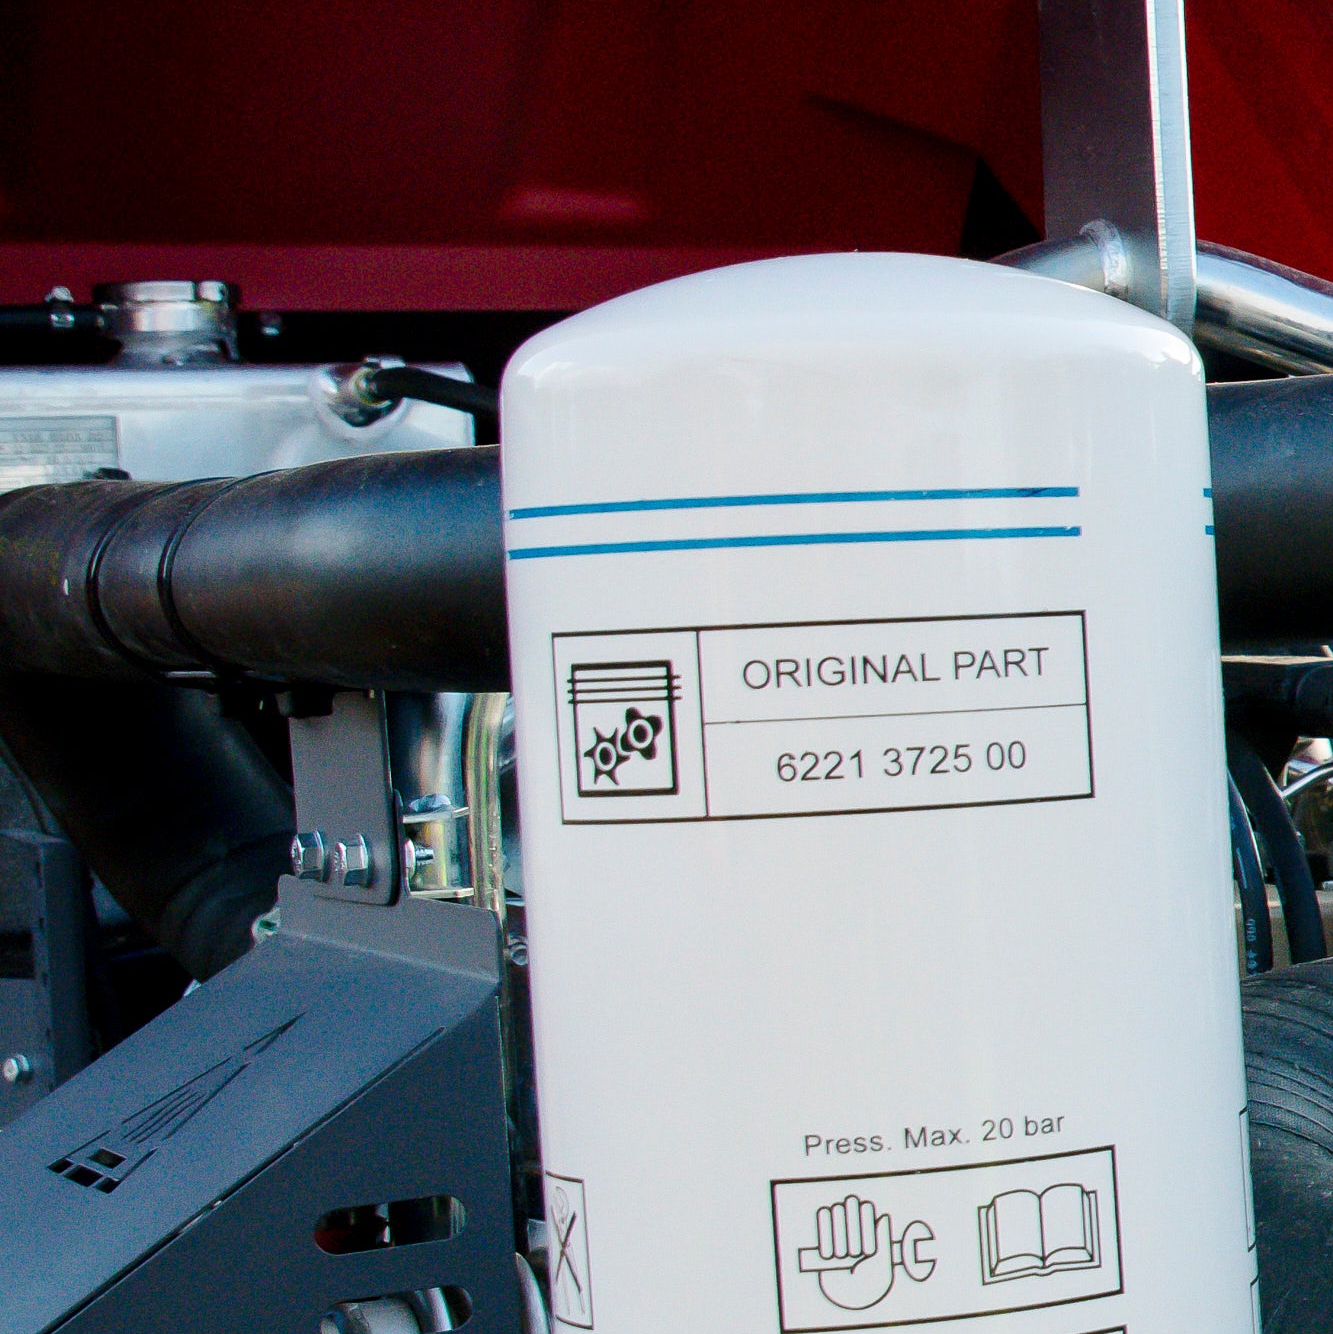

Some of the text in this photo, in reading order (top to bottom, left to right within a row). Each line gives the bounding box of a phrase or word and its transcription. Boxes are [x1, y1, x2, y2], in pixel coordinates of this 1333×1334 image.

[743, 646, 1050, 690] ORIGINAL PART
[776, 740, 1027, 783] 6221 3725 00
[804, 1115, 1064, 1156] Press. Max. 20 bar
